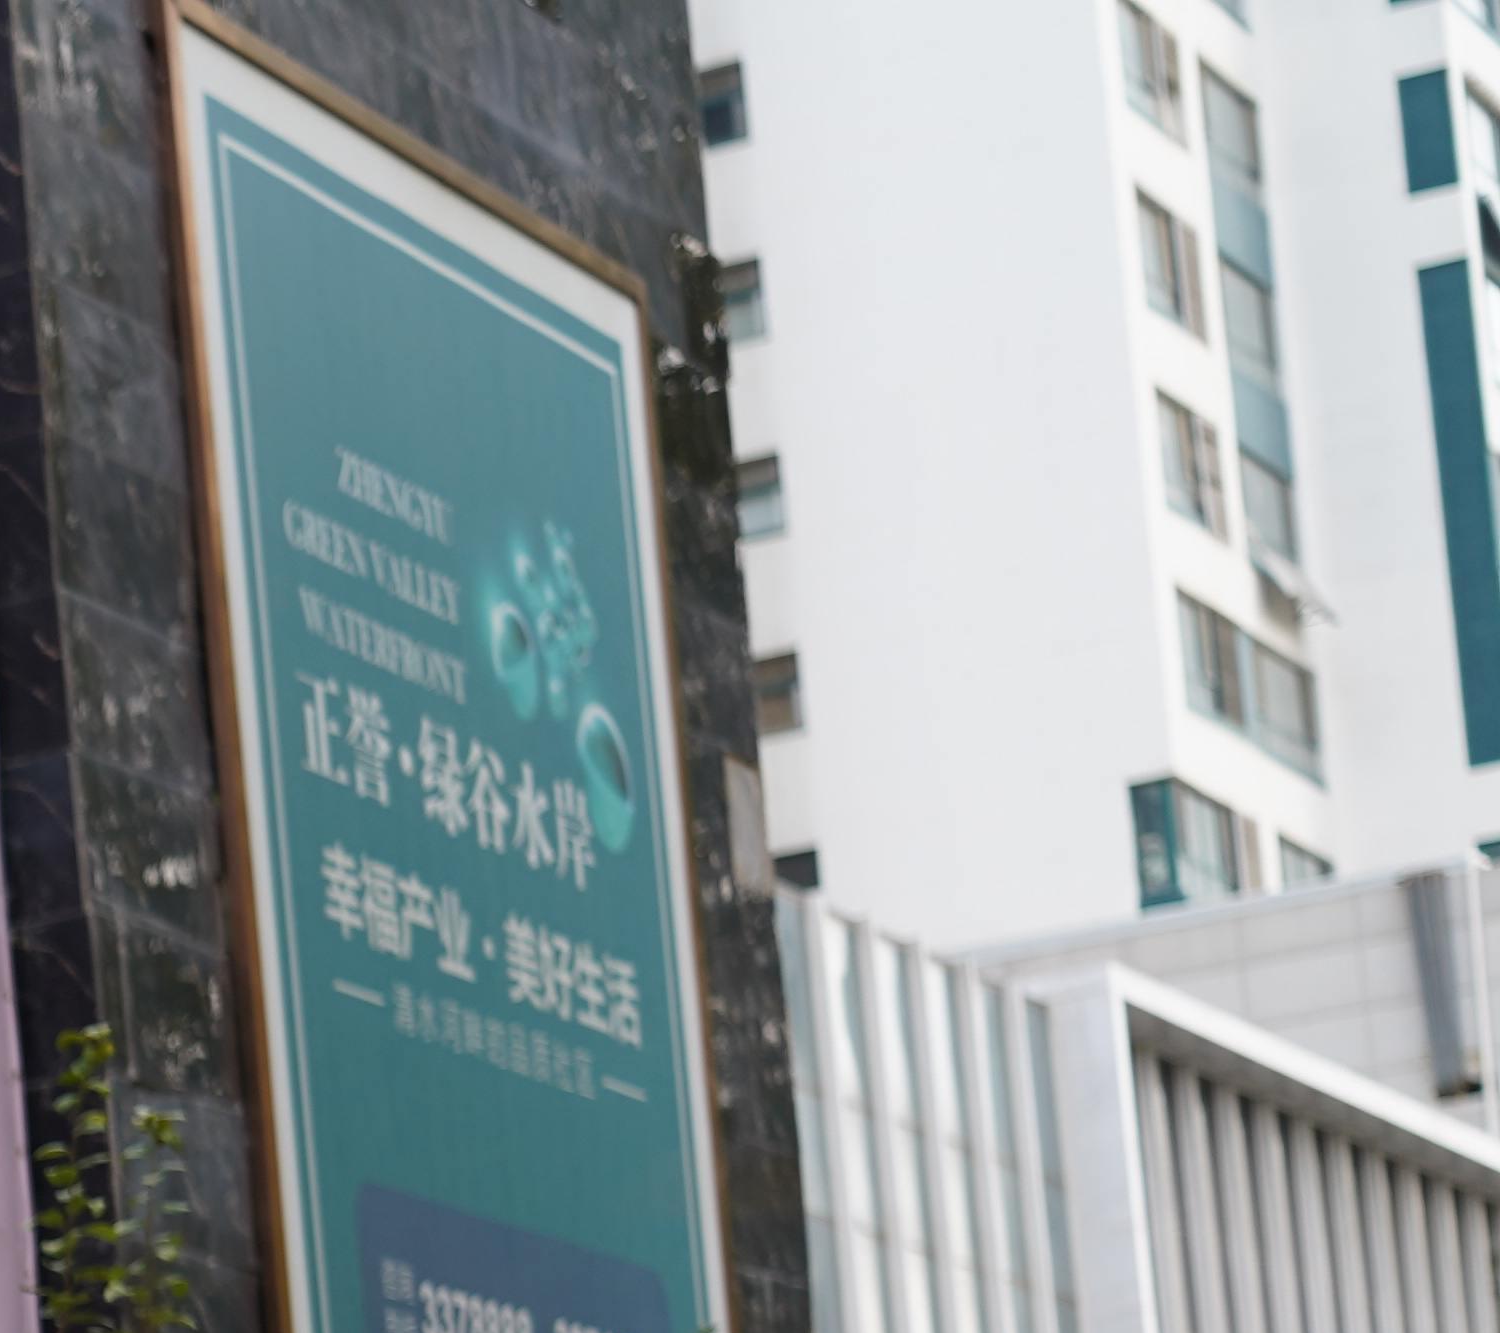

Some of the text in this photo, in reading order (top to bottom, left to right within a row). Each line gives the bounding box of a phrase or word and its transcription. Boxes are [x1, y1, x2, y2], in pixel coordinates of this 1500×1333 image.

[283, 498, 460, 625] GREEN VALLEY
[298, 584, 466, 705] WATERFRONT
